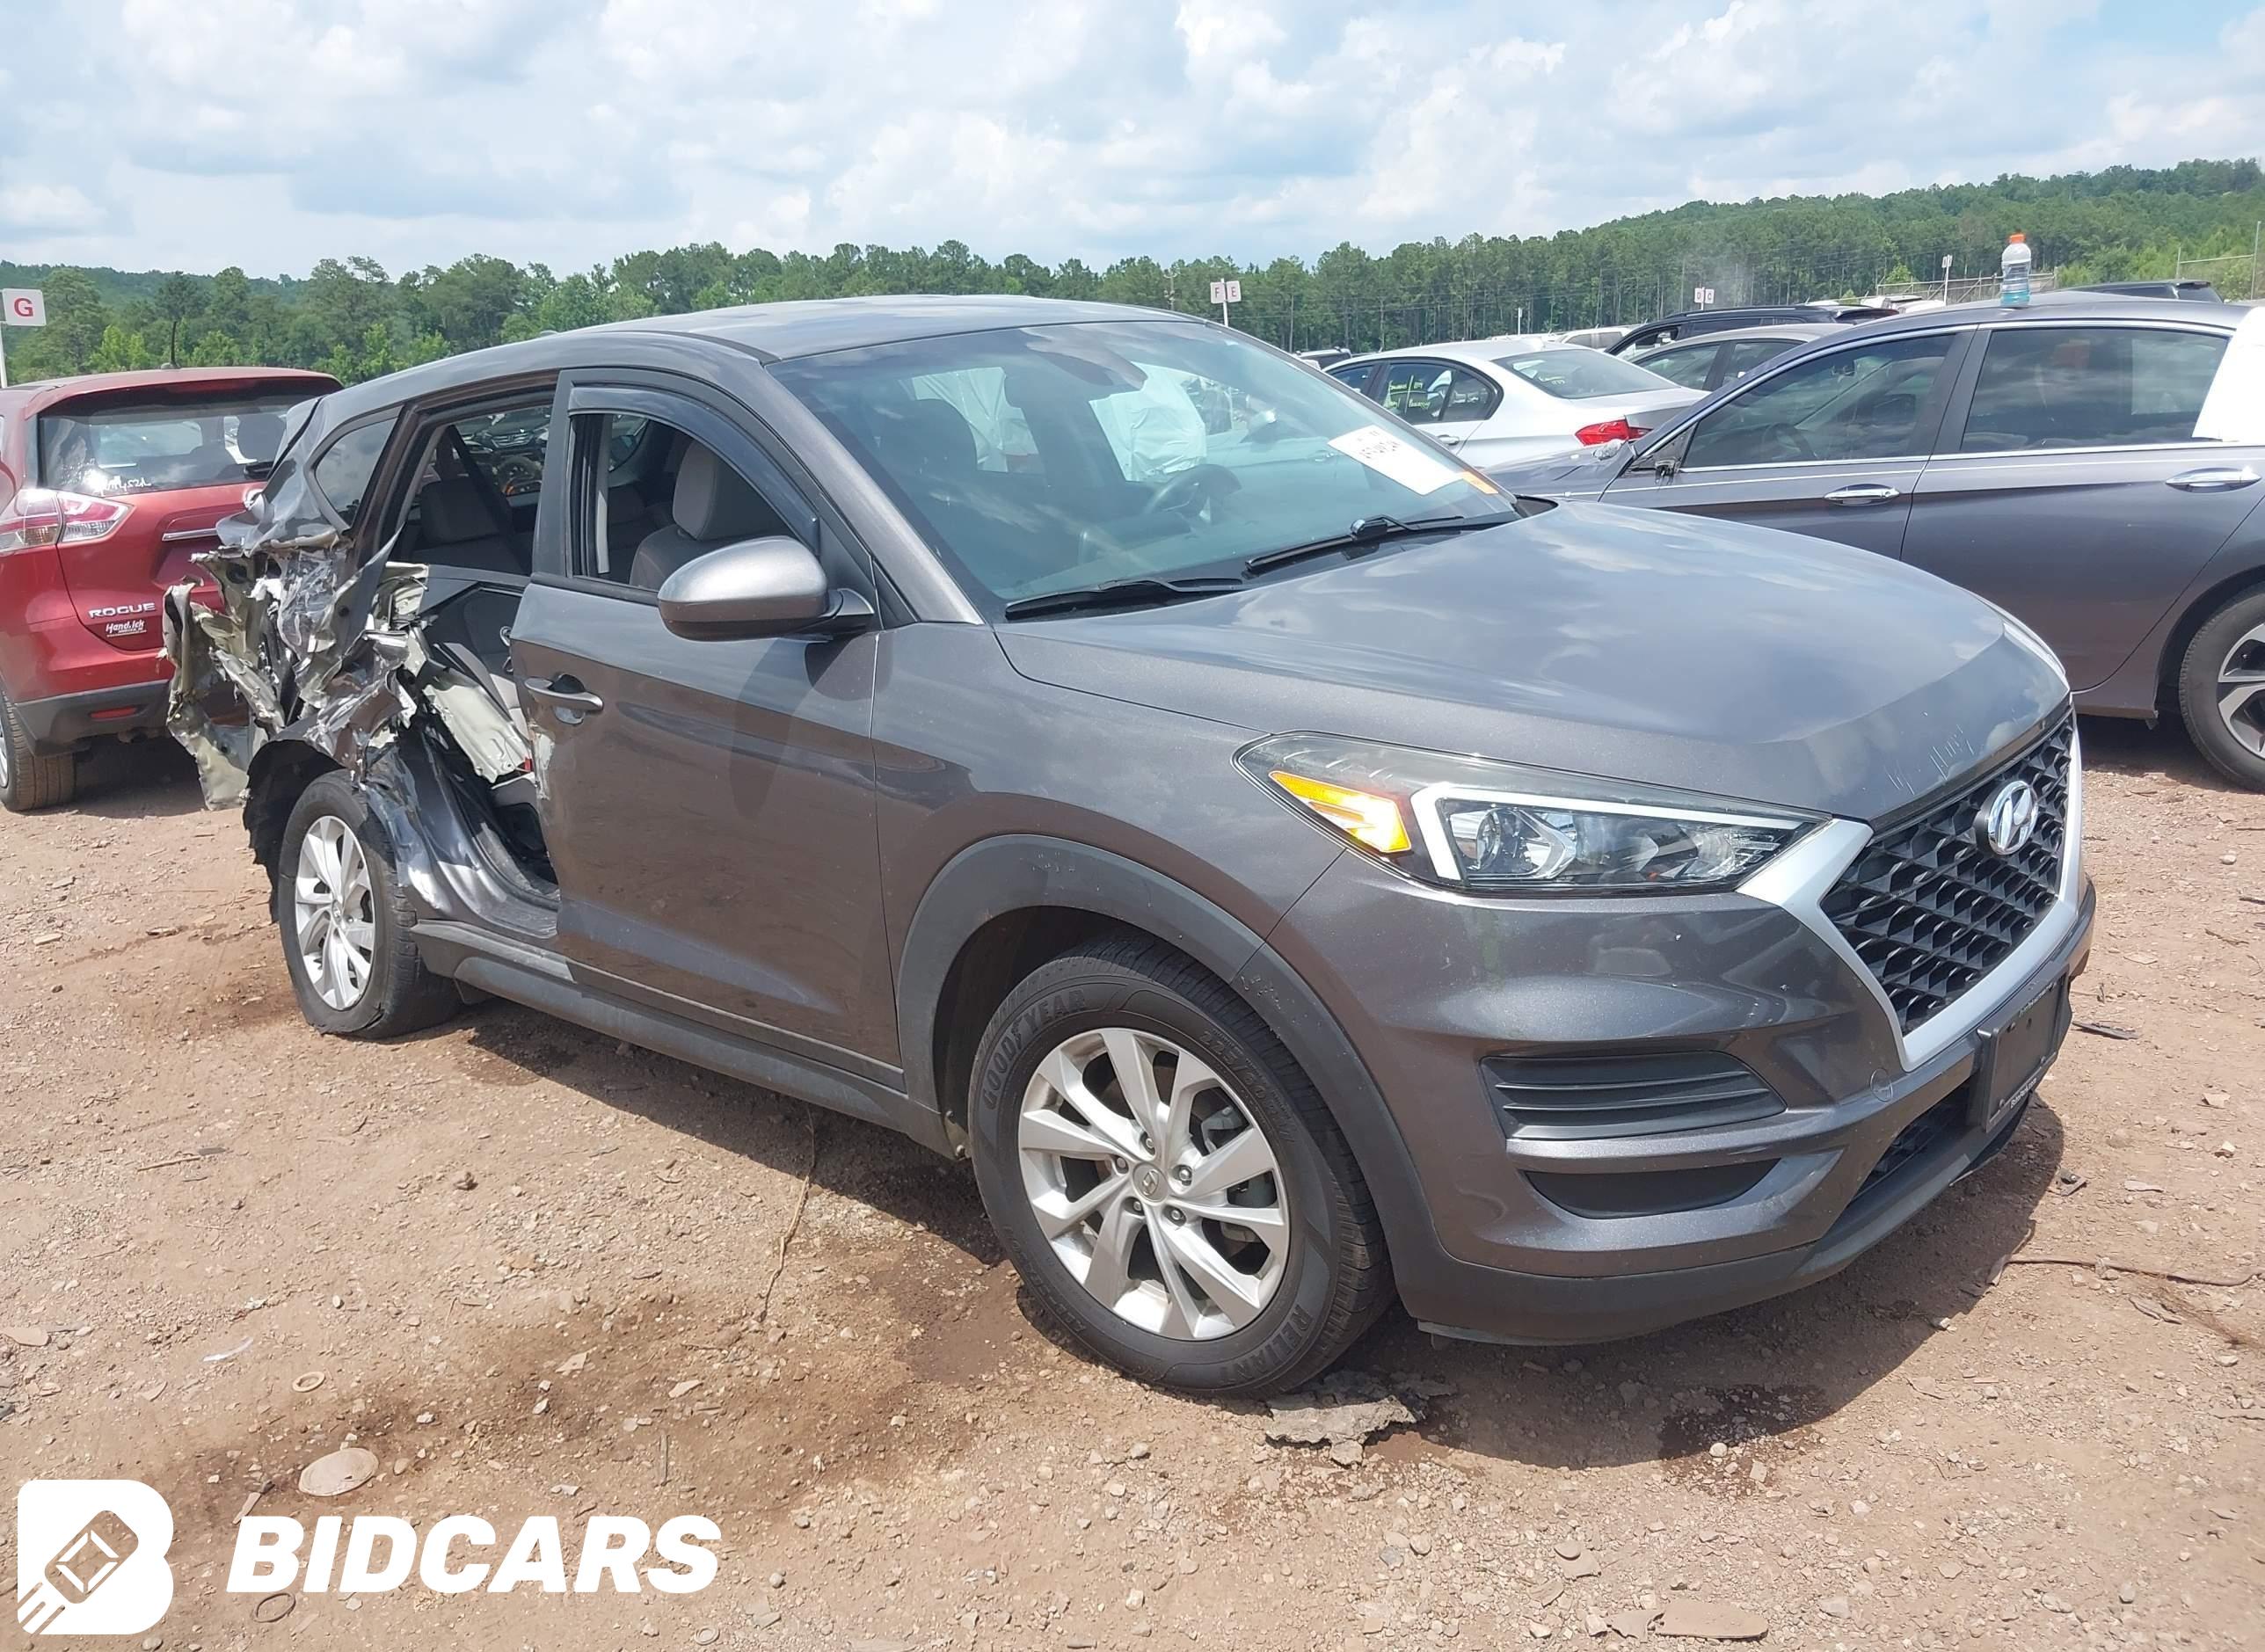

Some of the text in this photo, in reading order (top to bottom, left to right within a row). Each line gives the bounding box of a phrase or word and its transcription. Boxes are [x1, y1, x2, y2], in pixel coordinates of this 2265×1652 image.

[1214, 287, 1220, 298] F
[1231, 287, 1238, 297] E
[14, 297, 33, 317] G
[88, 602, 156, 618] ROGUE
[982, 988, 1086, 1110] GOODYEAR
